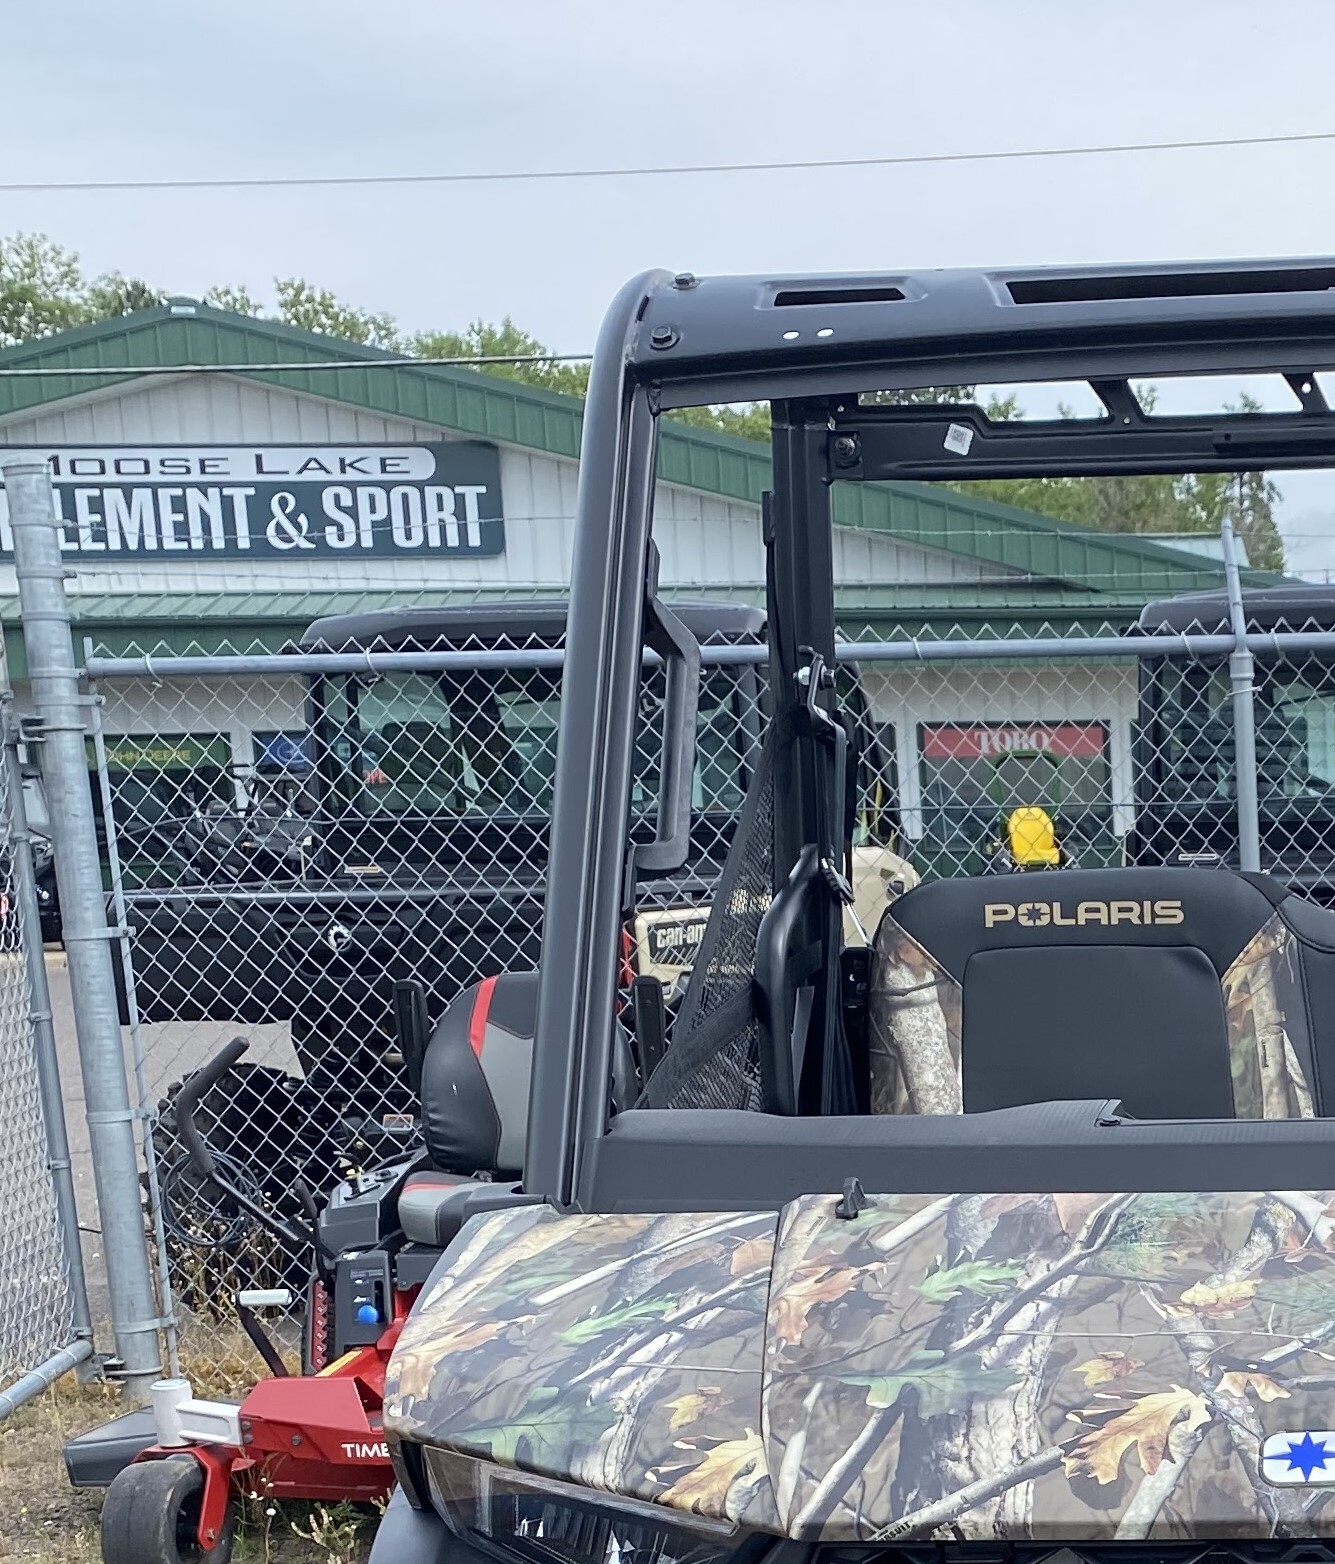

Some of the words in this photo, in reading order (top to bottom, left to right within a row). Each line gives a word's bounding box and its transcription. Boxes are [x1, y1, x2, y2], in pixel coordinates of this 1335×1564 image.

[0, 487, 256, 550] LEMENT
[266, 491, 316, 549] &
[321, 485, 487, 548] SPORT
[984, 900, 1186, 928] POLARIS
